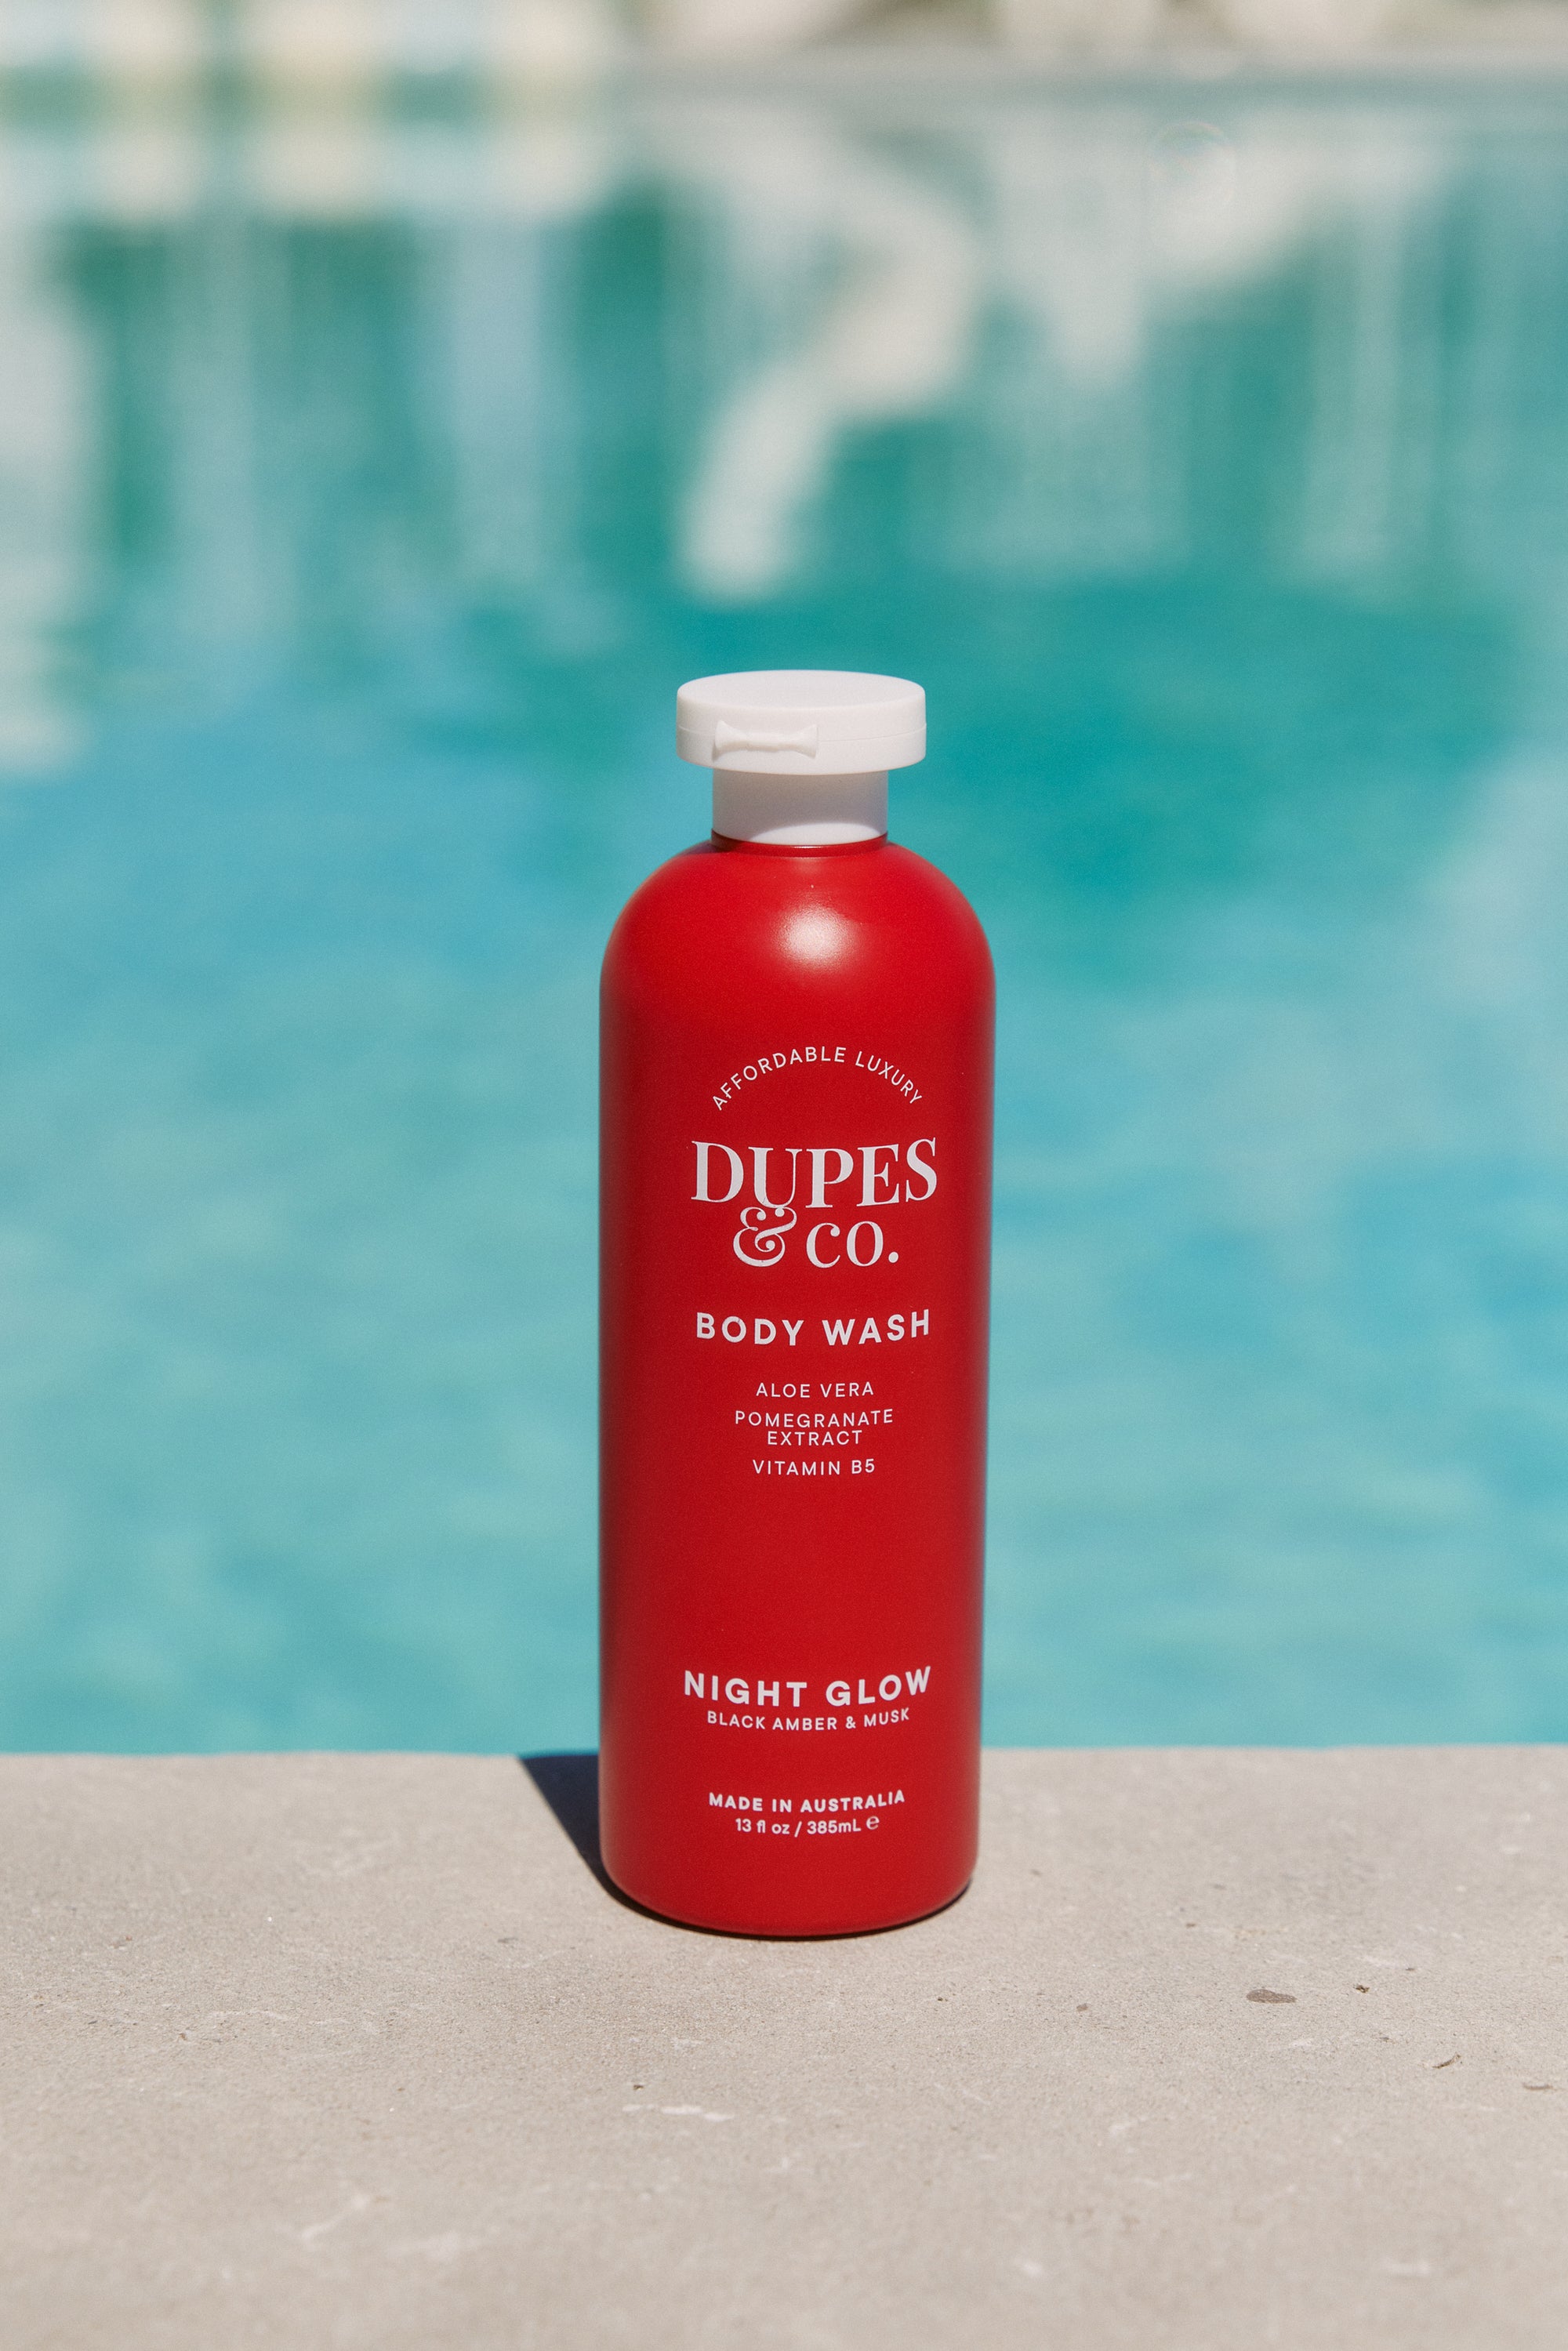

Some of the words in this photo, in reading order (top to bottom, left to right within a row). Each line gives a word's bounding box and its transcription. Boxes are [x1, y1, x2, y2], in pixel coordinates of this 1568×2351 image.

[713, 1046, 848, 1111] AFFORDABLE
[855, 1050, 923, 1104] LUXURY
[691, 1137, 938, 1210] DUPES
[732, 1206, 798, 1268] &
[695, 1312, 804, 1347] BODY
[821, 1308, 930, 1346] WASH
[756, 1382, 811, 1399] ALOE
[819, 1381, 874, 1399] VERA
[735, 1408, 894, 1428] POMEGRANATE
[767, 1430, 863, 1446] EXTRACT
[752, 1459, 841, 1476] VITAMIN
[851, 1458, 876, 1475] B5
[684, 1670, 808, 1707] NIGHT
[825, 1665, 931, 1707] GLOW
[707, 1710, 766, 1730] BLACK
[771, 1717, 838, 1732] AMBER
[845, 1715, 856, 1729] &
[863, 1707, 909, 1728] MUSK
[708, 1791, 764, 1812] MADE
[771, 1798, 792, 1813] IN
[800, 1789, 906, 1813] AUSTRALIA
[735, 1817, 753, 1833] 13
[757, 1819, 766, 1834] fl
[771, 1823, 790, 1835] oz
[793, 1820, 803, 1838] /
[807, 1818, 862, 1835] 385mL
